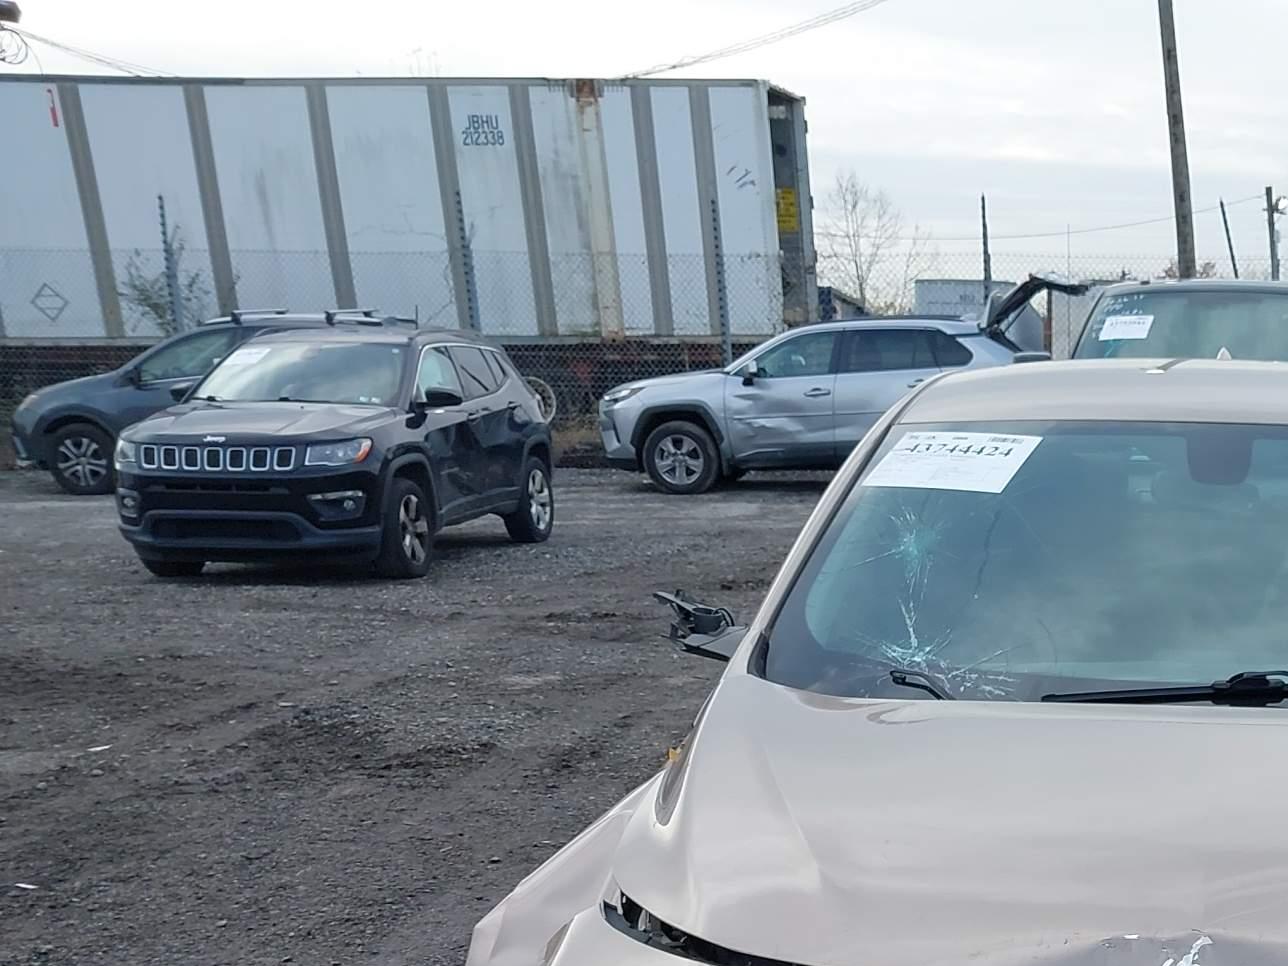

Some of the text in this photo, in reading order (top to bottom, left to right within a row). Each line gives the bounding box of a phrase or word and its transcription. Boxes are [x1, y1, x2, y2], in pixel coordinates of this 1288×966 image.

[465, 114, 499, 130] JBHU
[462, 130, 505, 146] 212338
[903, 442, 1014, 458] 43744424
